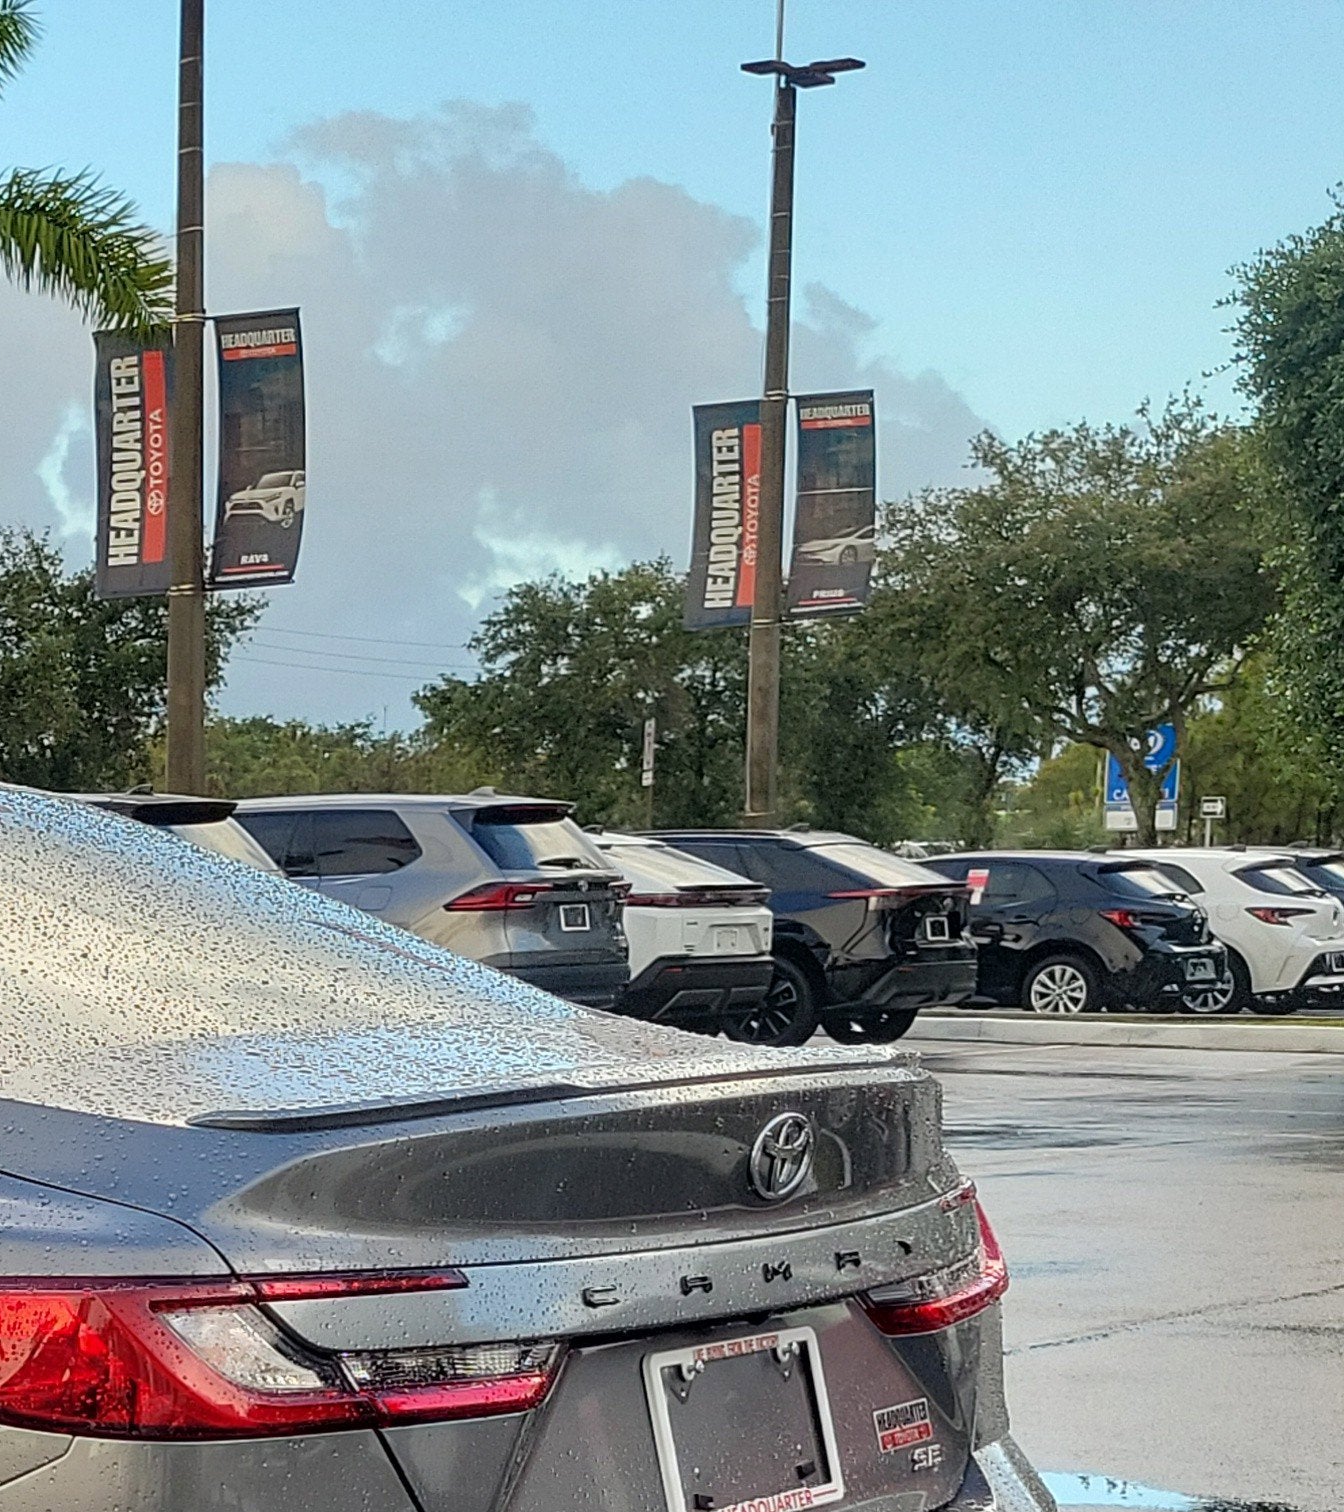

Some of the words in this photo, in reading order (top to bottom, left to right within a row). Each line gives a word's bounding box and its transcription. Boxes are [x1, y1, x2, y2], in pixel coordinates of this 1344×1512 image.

[221, 328, 296, 349] HEADQUARTER
[149, 408, 164, 488] TOYOTA
[800, 404, 870, 420] HEADQUARTER
[108, 355, 146, 567] HEADQUARTER
[703, 427, 743, 609] HEADQUARTER
[745, 473, 761, 546] TOYOTA
[913, 1443, 942, 1471] SE
